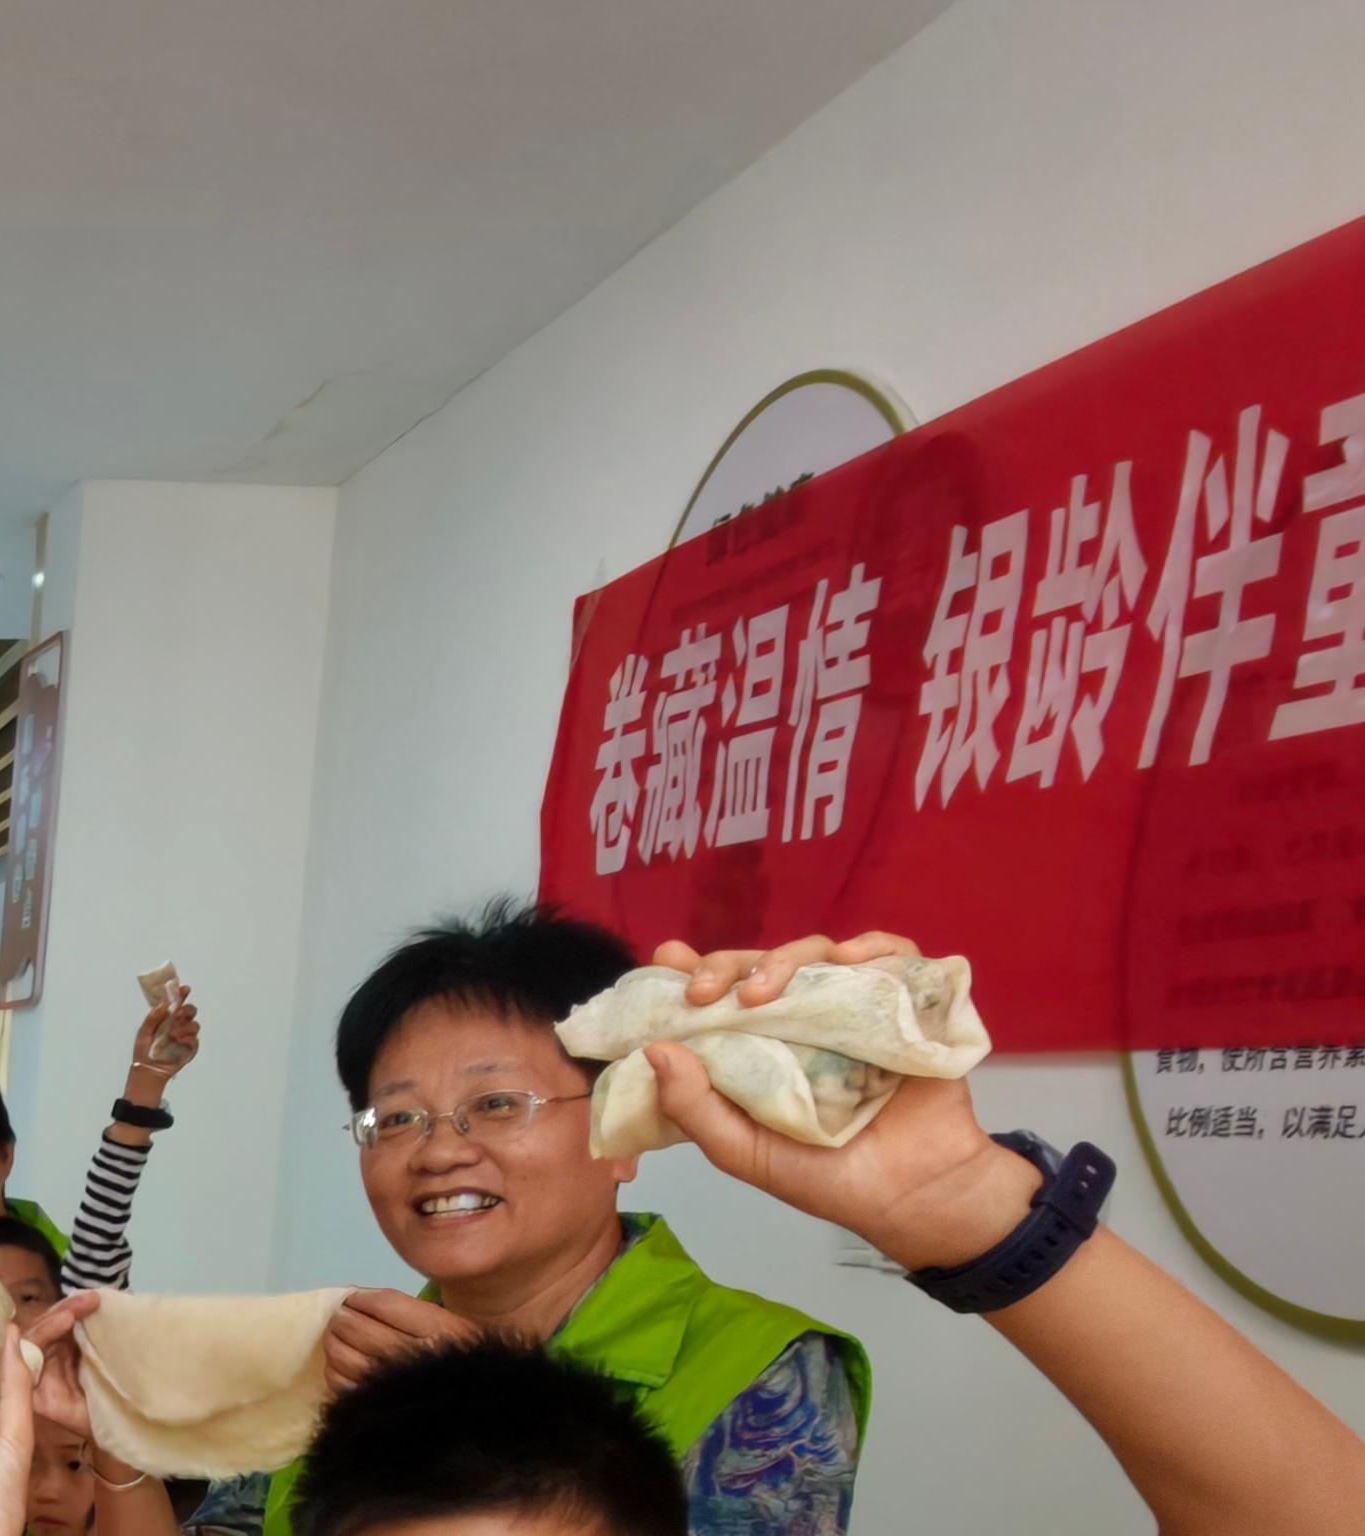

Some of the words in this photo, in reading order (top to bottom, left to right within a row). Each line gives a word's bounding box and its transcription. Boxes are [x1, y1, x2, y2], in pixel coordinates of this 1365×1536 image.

[590, 562, 882, 875] 卷藏温情
[1165, 1105, 1365, 1140] 比例适当，以满足
